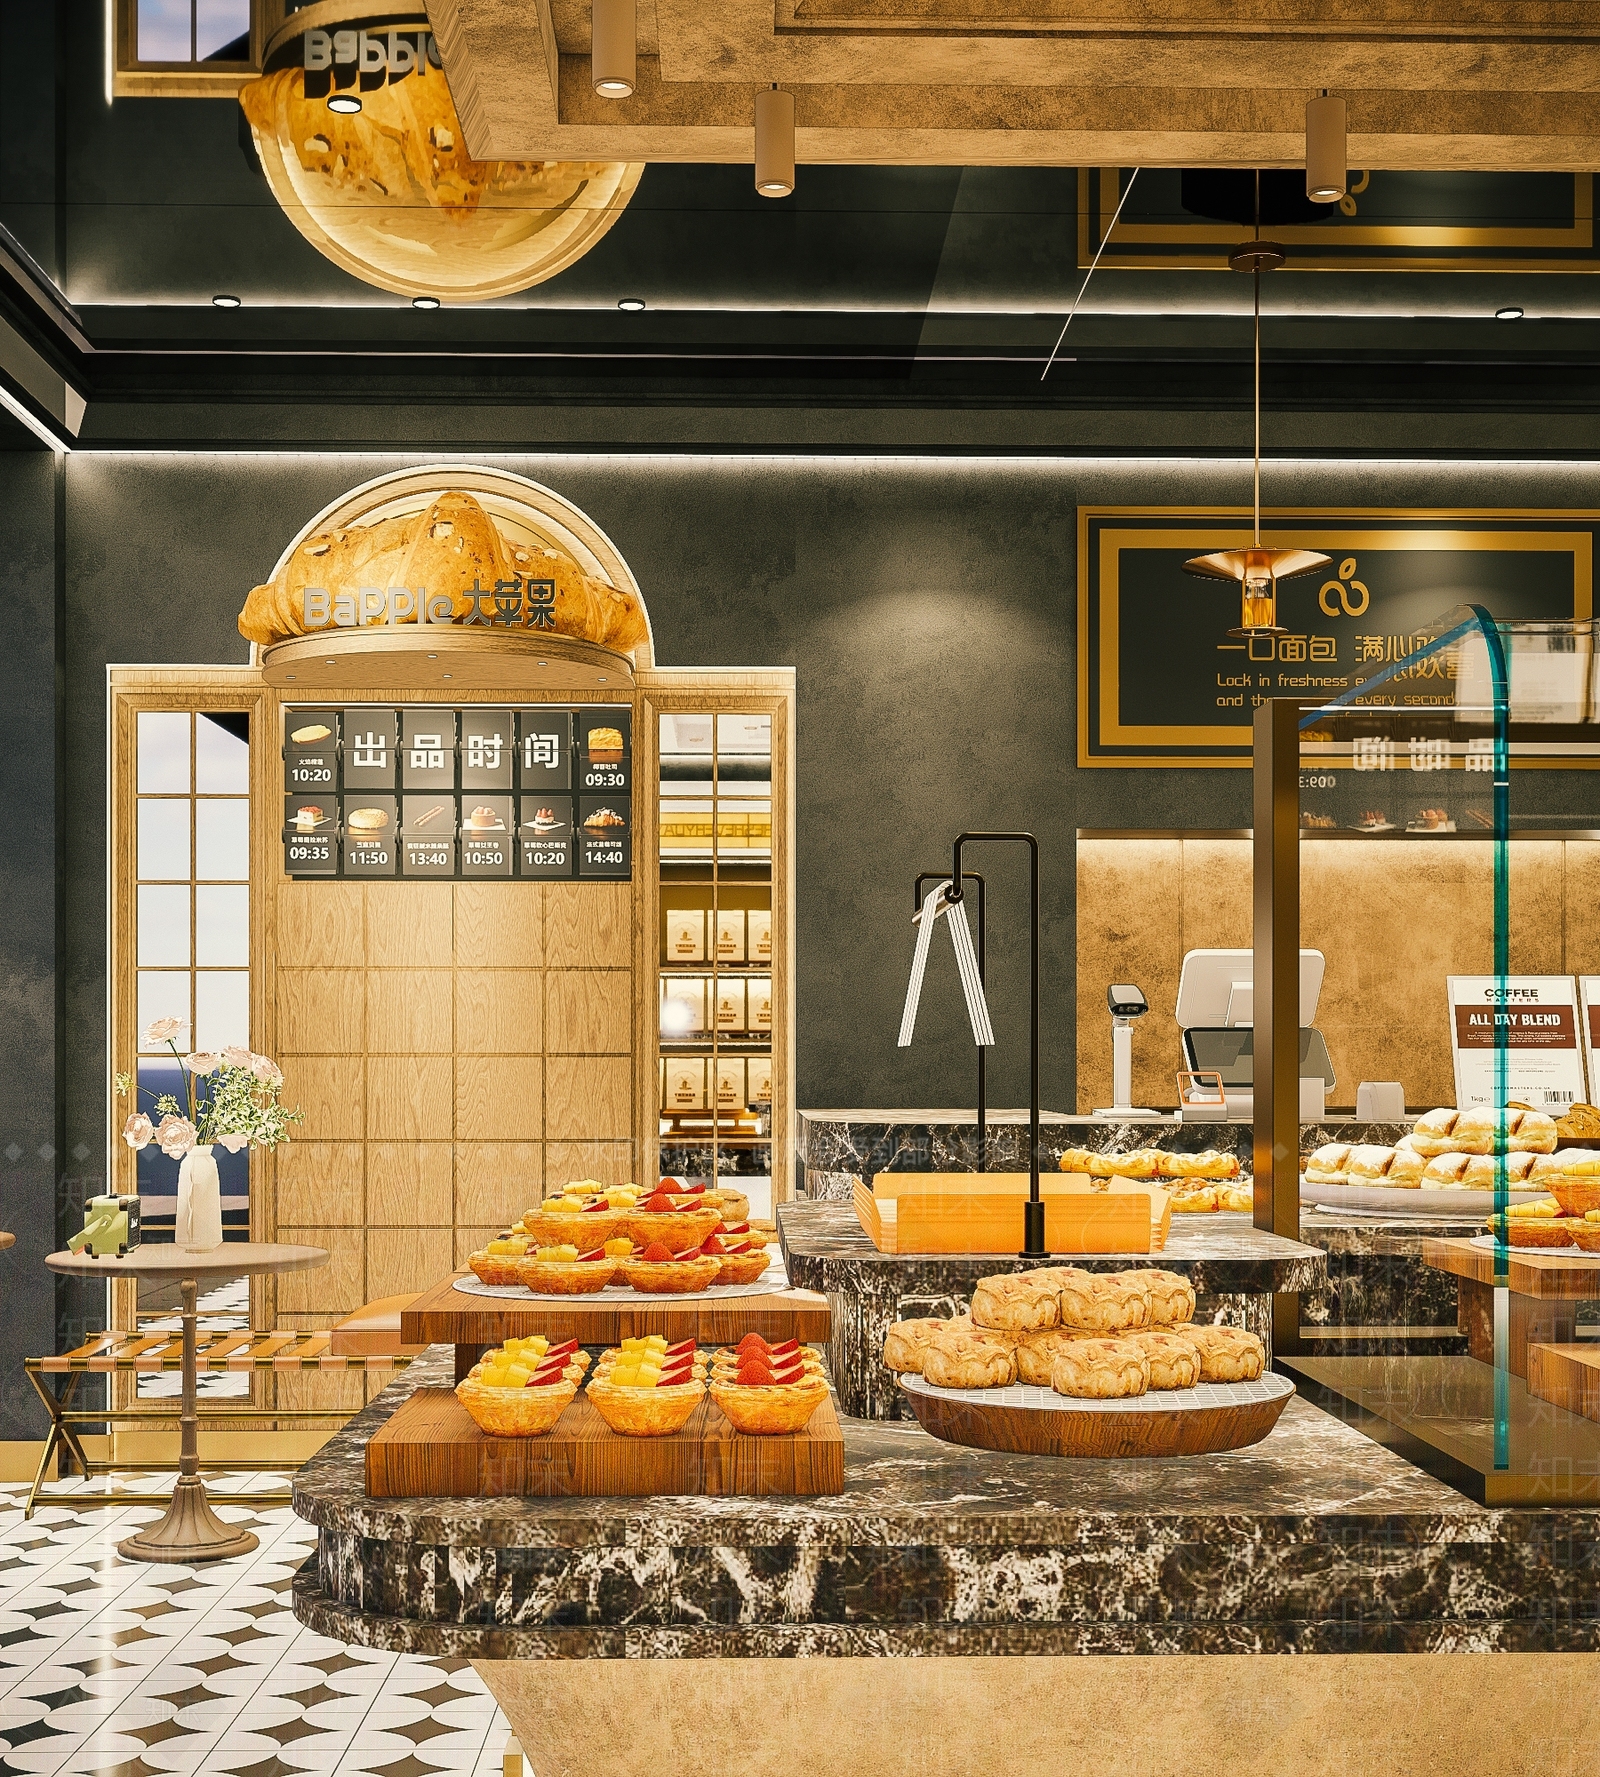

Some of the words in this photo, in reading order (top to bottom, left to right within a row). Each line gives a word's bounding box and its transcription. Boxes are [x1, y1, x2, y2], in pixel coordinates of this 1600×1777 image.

[462, 578, 557, 628] 大苹果
[1216, 635, 1339, 662] 一口面包
[1217, 673, 1252, 687] Lock
[1259, 673, 1270, 687] in
[1278, 673, 1348, 687] freshness
[1216, 694, 1244, 707] and
[1355, 695, 1397, 707] every
[353, 731, 560, 770] 出品时间
[291, 768, 332, 782] 10:20
[585, 773, 625, 786] 09:30
[289, 846, 330, 860] 09:35
[349, 851, 388, 864] 11:50
[409, 852, 447, 865] 13:40
[464, 851, 503, 865] 10:50
[525, 851, 565, 865] 10:20
[585, 851, 623, 864] 14:40
[1484, 988, 1539, 998] COFFEE
[1469, 1013, 1492, 1026] ALL
[1494, 1013, 1518, 1026] DAY
[1521, 1013, 1561, 1026] BLEND
